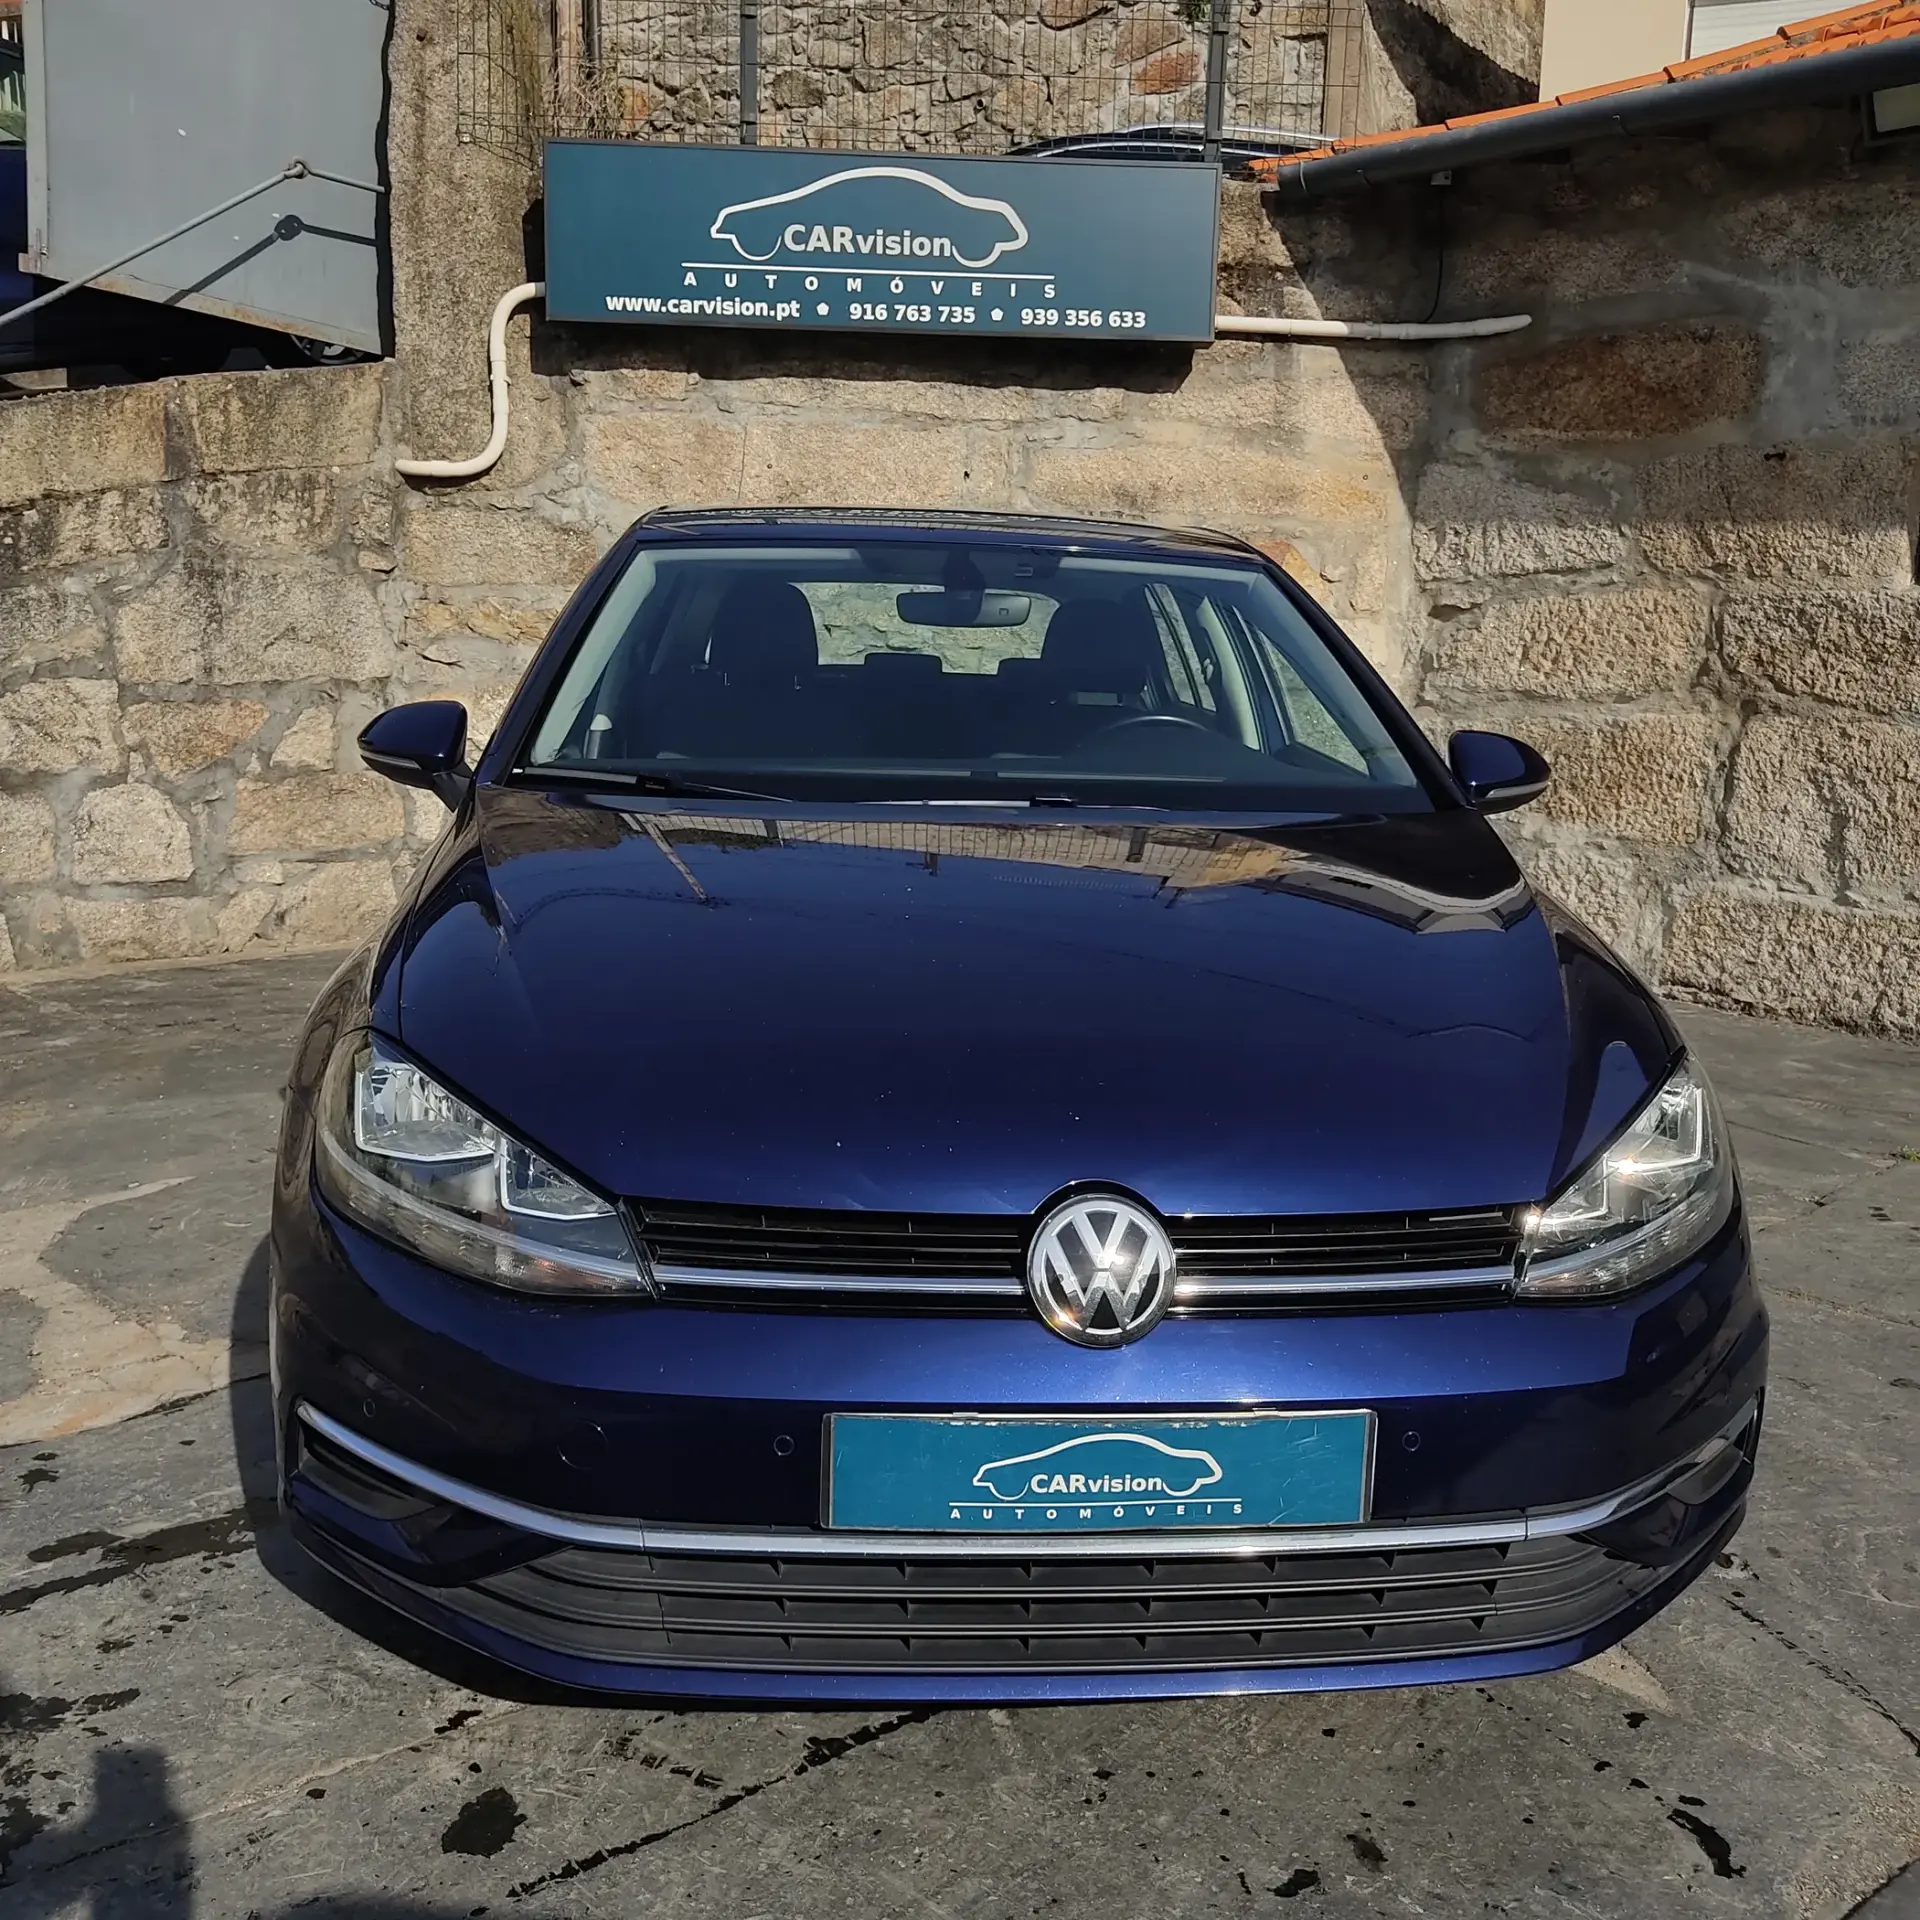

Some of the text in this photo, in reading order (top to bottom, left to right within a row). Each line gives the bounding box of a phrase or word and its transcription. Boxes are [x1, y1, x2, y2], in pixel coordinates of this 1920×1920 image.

[783, 224, 952, 256] CARvision
[683, 271, 1056, 299] AUTOMÓVEIS
[605, 296, 1146, 328] www.carvision.pt 916 763 735 939 356 633
[1030, 1474, 1163, 1493] CARvision
